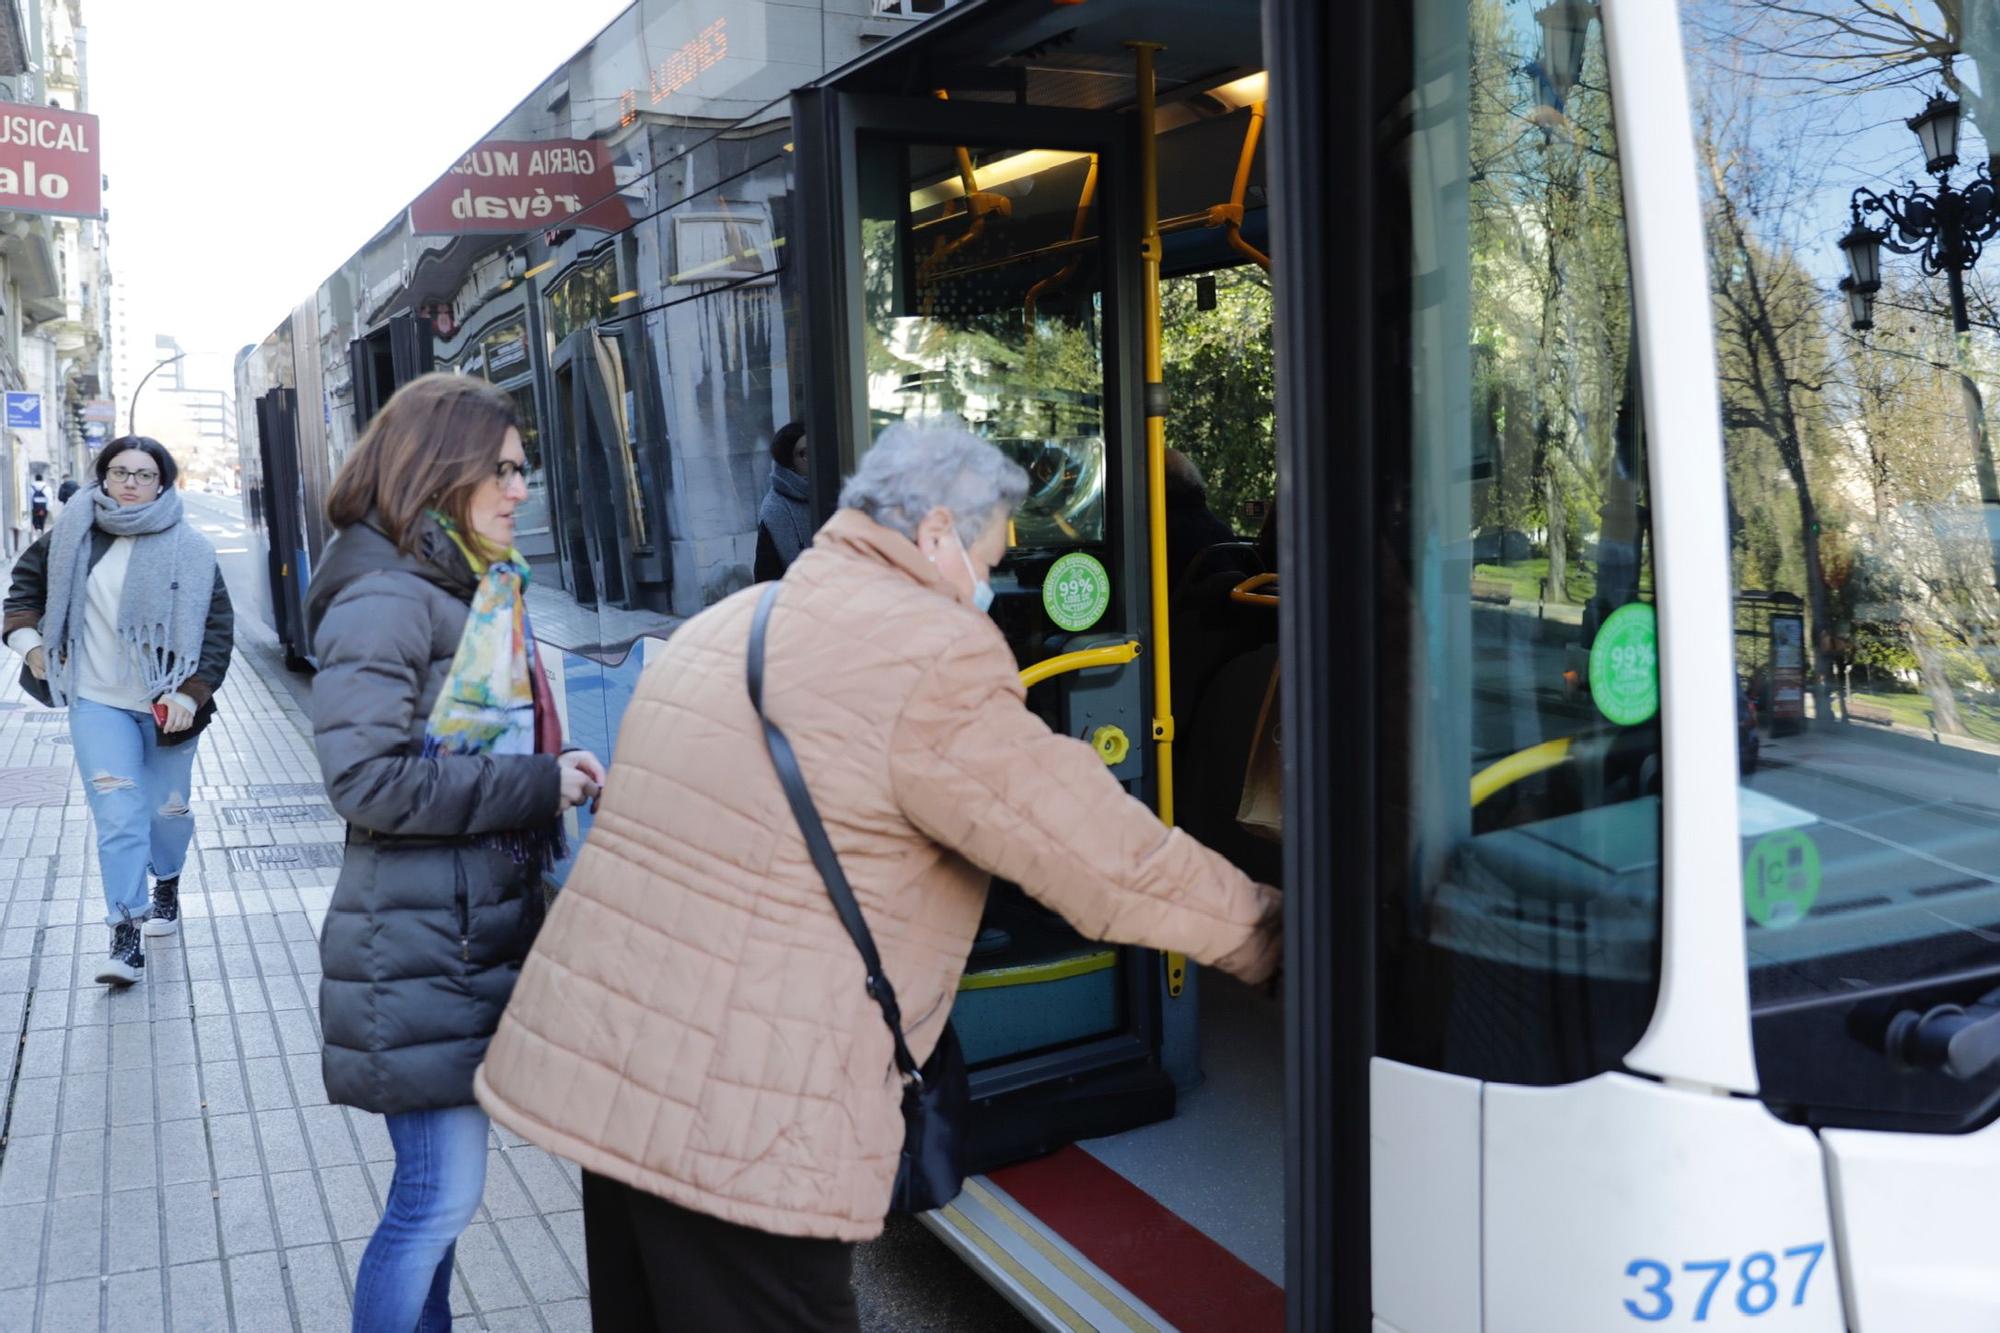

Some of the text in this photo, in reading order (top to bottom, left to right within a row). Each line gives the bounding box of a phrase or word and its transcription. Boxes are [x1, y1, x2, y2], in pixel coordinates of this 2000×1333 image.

[651, 17, 727, 104] LUGONES
[1059, 577, 1094, 597] 99%
[1611, 643, 1656, 671] 99%
[1622, 1240, 1825, 1322] 3787
